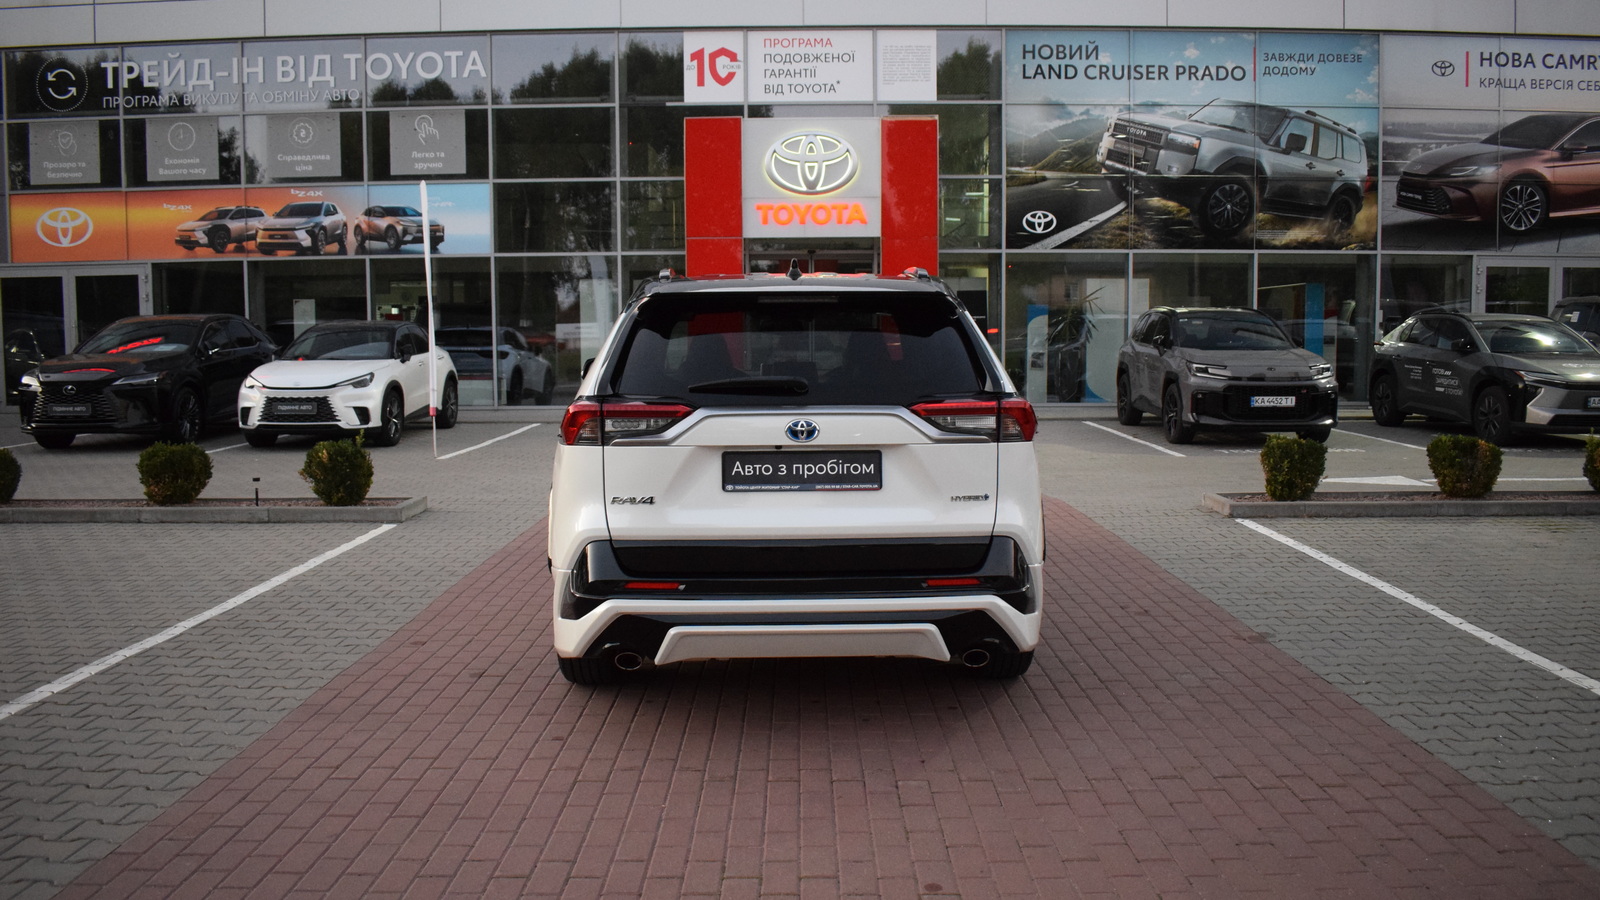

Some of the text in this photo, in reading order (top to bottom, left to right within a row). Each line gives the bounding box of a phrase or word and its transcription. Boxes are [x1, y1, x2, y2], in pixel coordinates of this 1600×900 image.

[763, 38, 833, 48] ПРОГРАМА
[1022, 41, 1100, 60] НОВИЙ
[763, 50, 856, 65] ПОДОВЖЕНОЇ
[1263, 52, 1363, 64] ЗАВЖДИ ДОВЕЗЕ
[1480, 51, 1536, 68] НОВА
[100, 50, 487, 92] ТРЕЙД-ІН ВІД TOYOTA
[763, 66, 817, 79] ГАРАНТІЇ
[1022, 63, 1247, 82] LAND CRUISER PRADO
[1262, 66, 1316, 77] ДОДОМУ
[763, 83, 784, 96] ВІД
[1479, 77, 1527, 91] КРАЩА
[1530, 79, 1574, 90] ВЕРСІЯ
[102, 88, 360, 108] ПРОГРАМА ВИКУПУ ТА ОБМІНУ АВТО
[1126, 126, 1147, 137] TOYOTA
[277, 153, 331, 162] Справедлива
[411, 151, 435, 159] Легко
[43, 161, 77, 170] Прозоро
[164, 157, 200, 165] Економія
[413, 161, 443, 169] зручно
[188, 167, 207, 175] часу
[295, 164, 313, 172] ціна
[46, 170, 83, 178] безпечно
[755, 203, 868, 226] TOYOTA
[1254, 397, 1266, 405] KA
[1266, 397, 1284, 405] 4452
[731, 459, 875, 478] Авто з пробігом
[610, 495, 656, 505] RAV4
